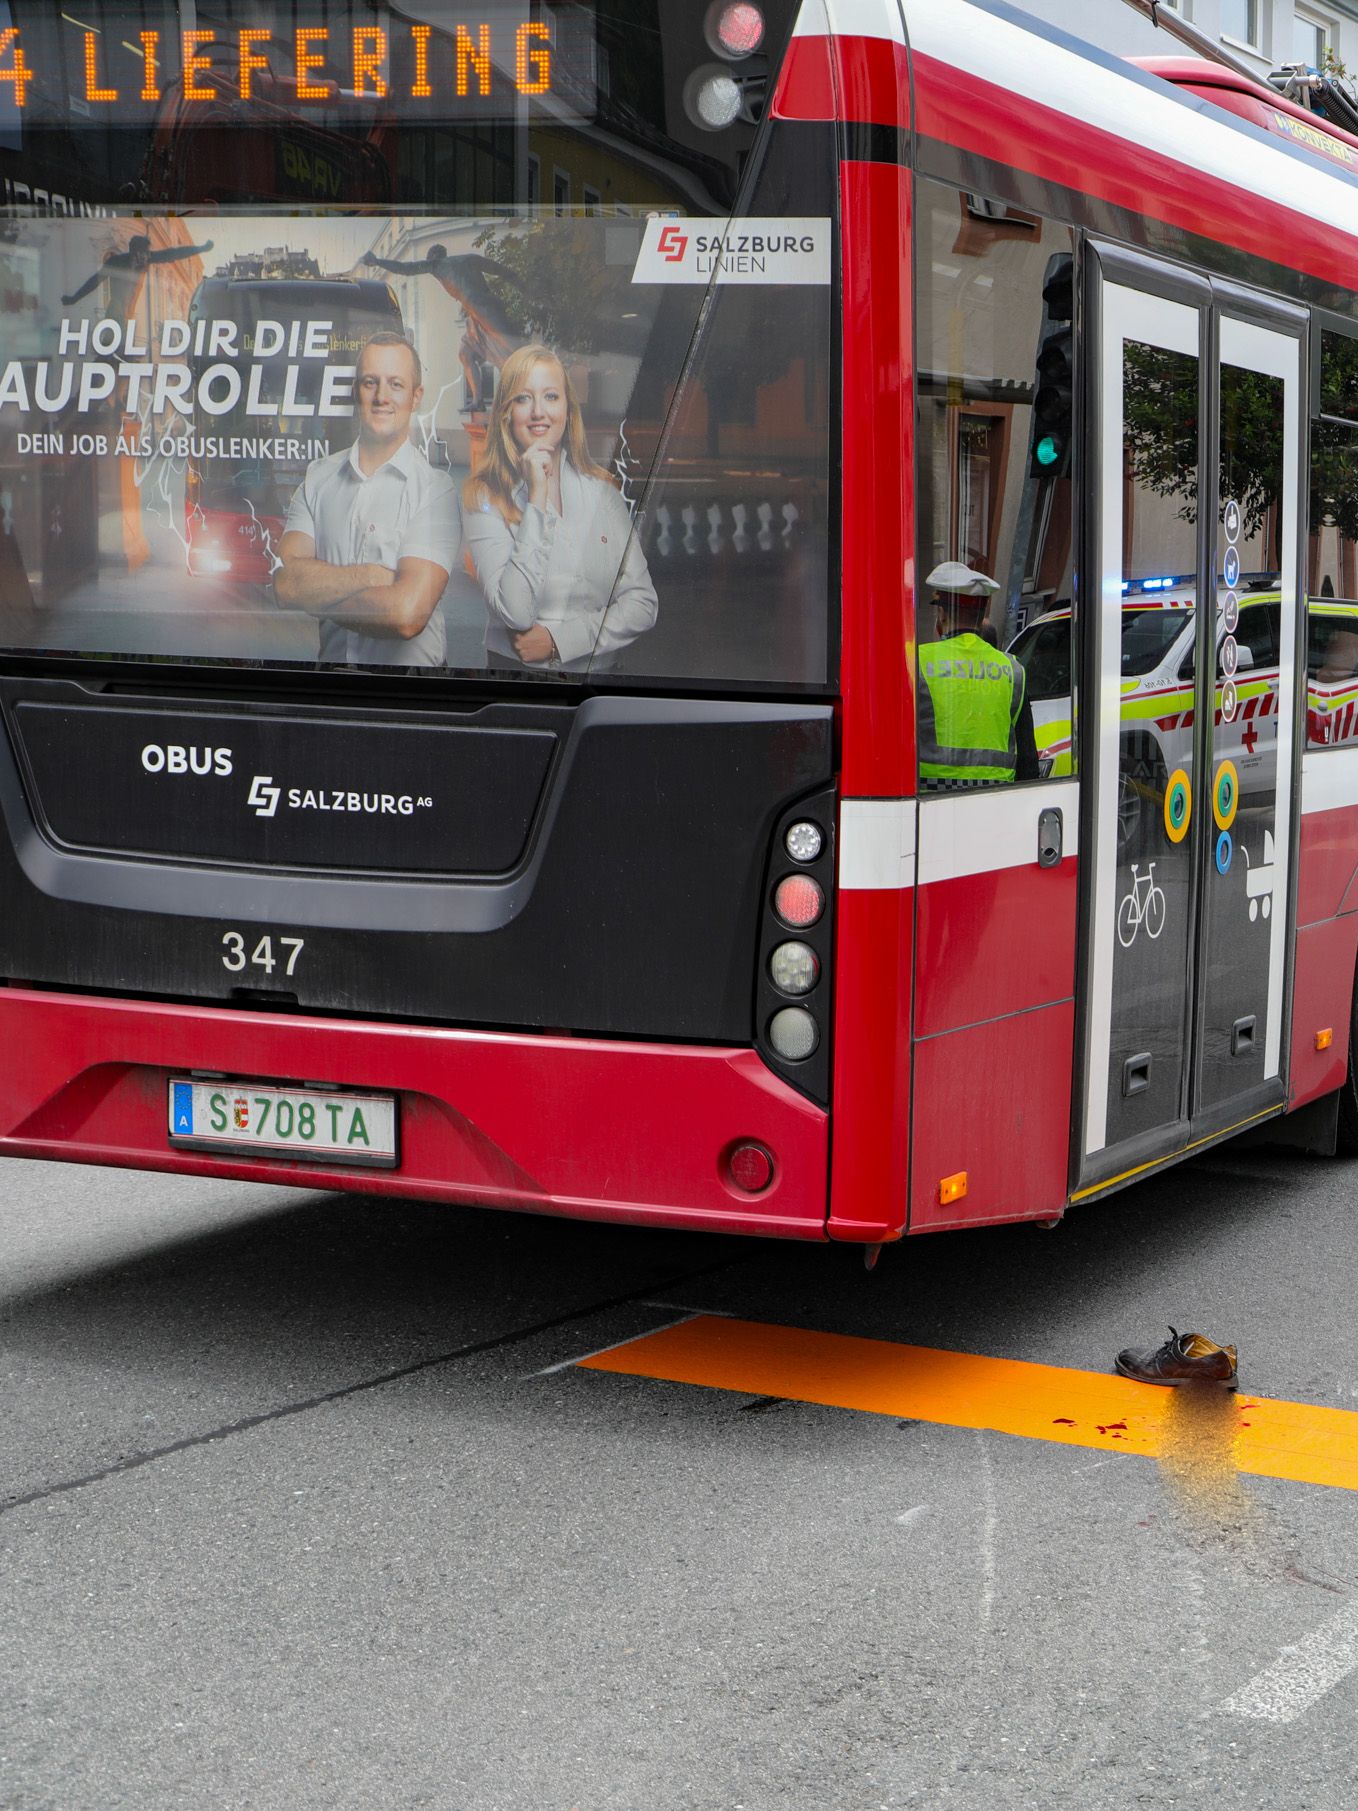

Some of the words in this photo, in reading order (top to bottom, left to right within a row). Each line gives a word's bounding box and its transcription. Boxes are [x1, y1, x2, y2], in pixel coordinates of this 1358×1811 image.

[0, 27, 33, 107] 4
[84, 22, 550, 101] LIEFERING
[696, 236, 815, 253] SALZBURG
[696, 256, 766, 273] LINIEN
[58, 318, 148, 357] HOL
[160, 319, 239, 357] DIR
[252, 320, 333, 358] DIE
[17, 433, 64, 455] DEIN
[70, 434, 108, 455] JOB
[115, 435, 152, 457] ALS
[159, 435, 330, 460] OBUSLENKER:IN
[141, 744, 233, 776] OBUS
[288, 788, 414, 815] SALZBURG
[417, 796, 433, 807] AG
[222, 931, 304, 976] 347
[179, 1115, 189, 1127] A
[210, 1093, 228, 1132] S
[254, 1098, 315, 1140] 708
[325, 1104, 370, 1146] TA
